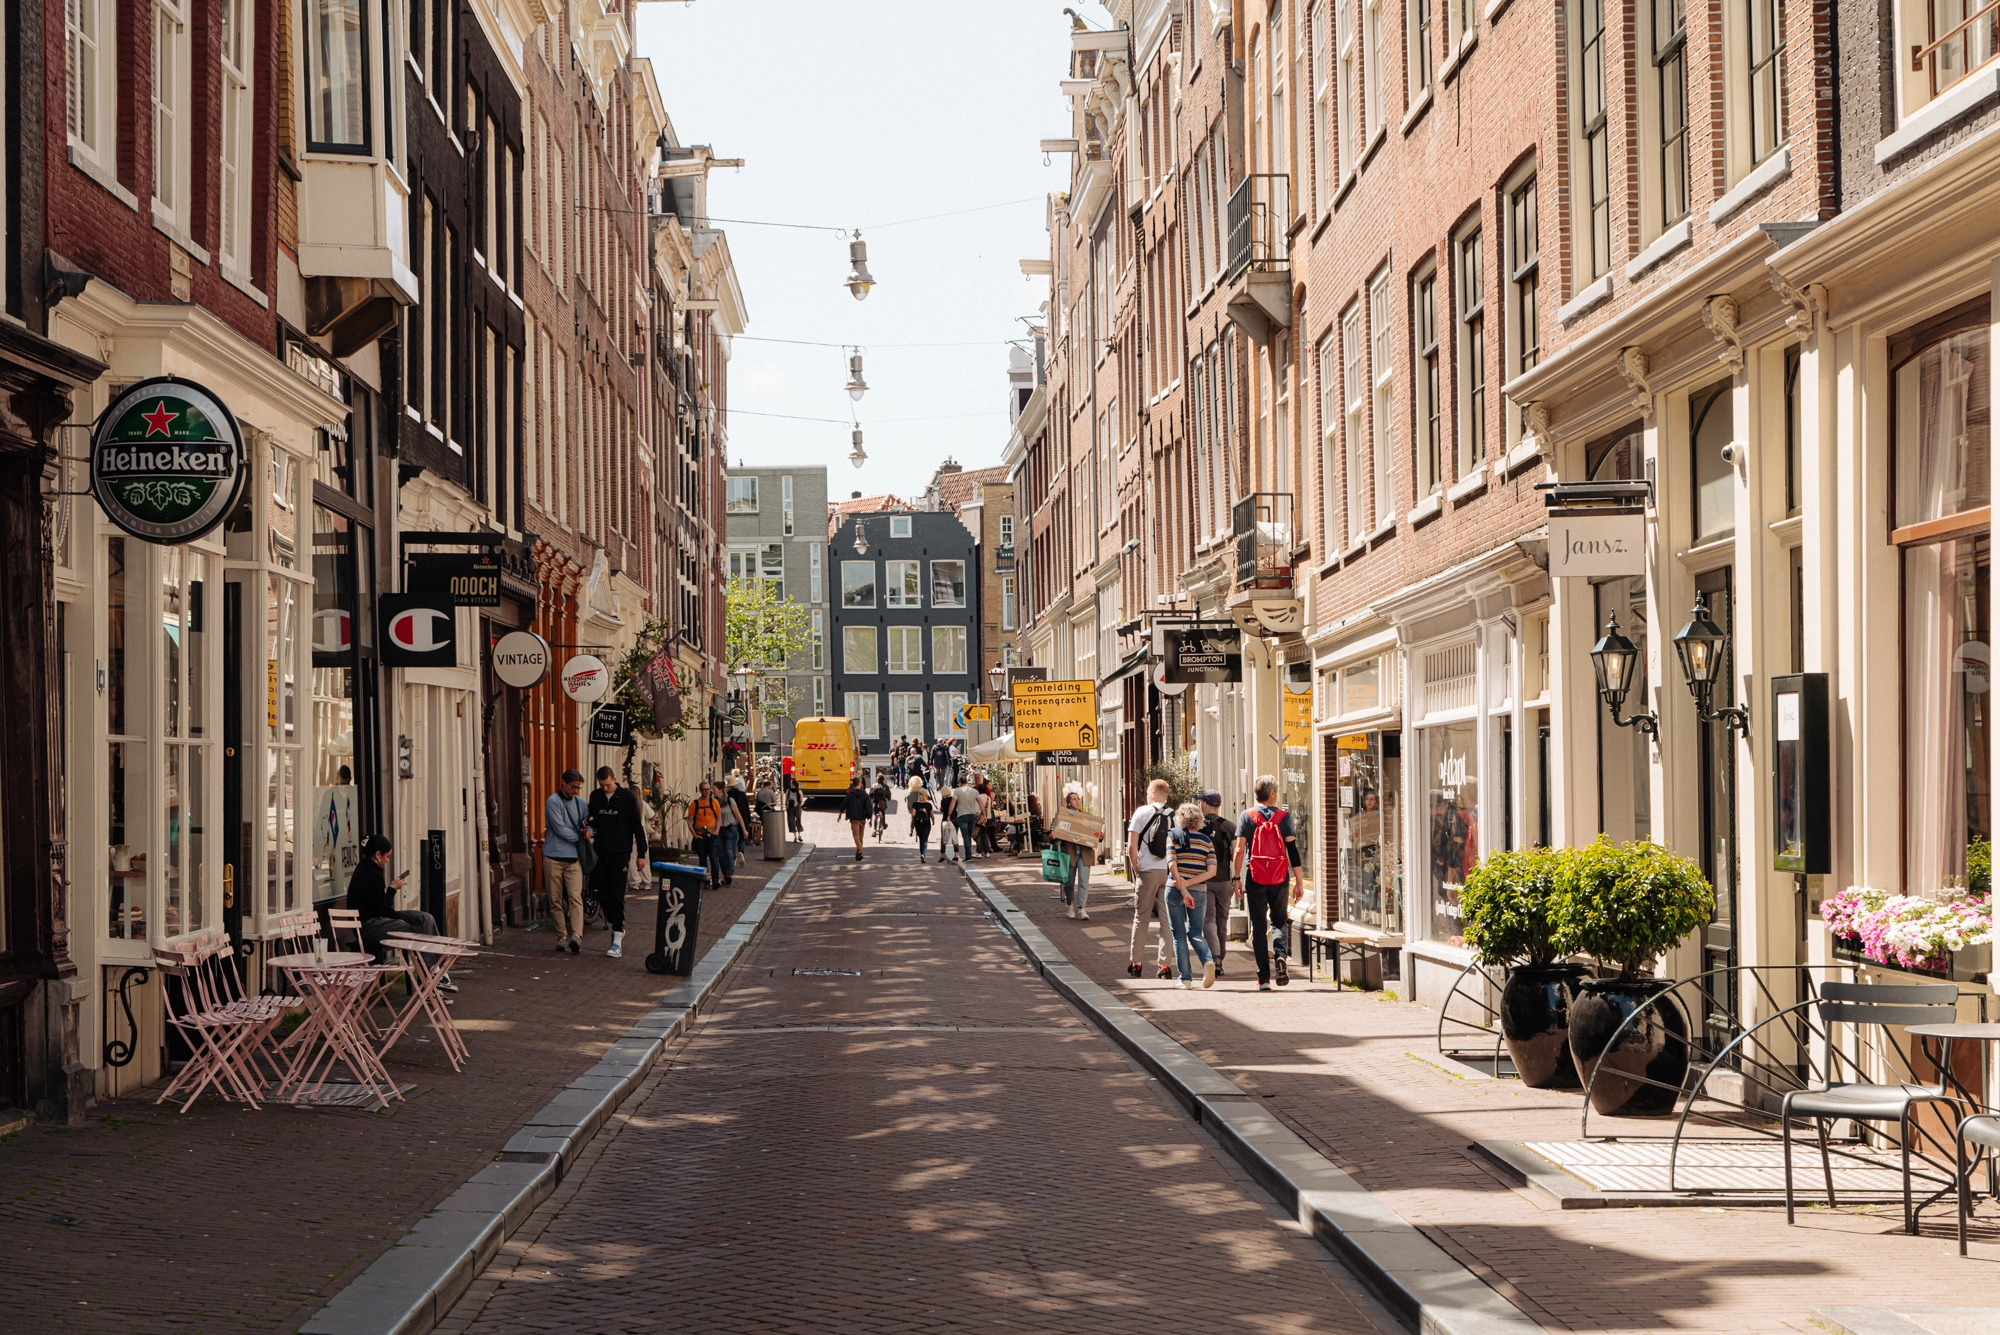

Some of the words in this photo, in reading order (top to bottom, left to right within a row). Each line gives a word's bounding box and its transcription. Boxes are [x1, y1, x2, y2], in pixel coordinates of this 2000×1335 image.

[101, 446, 226, 472] Heineken
[111, 503, 162, 534] PREMIUM
[171, 503, 219, 534] QUALITY
[1562, 529, 1628, 566] Jansz.
[497, 653, 543, 665] VINTAGE
[1027, 683, 1081, 692] omleiding
[1016, 696, 1087, 706] Prinsengracht
[1016, 708, 1042, 716] dicht
[598, 713, 617, 721] Muze
[601, 722, 614, 730] the
[1017, 720, 1080, 729] Rozengracht
[595, 731, 618, 740] Store
[1082, 733, 1091, 743] R
[1019, 736, 1040, 745] volg
